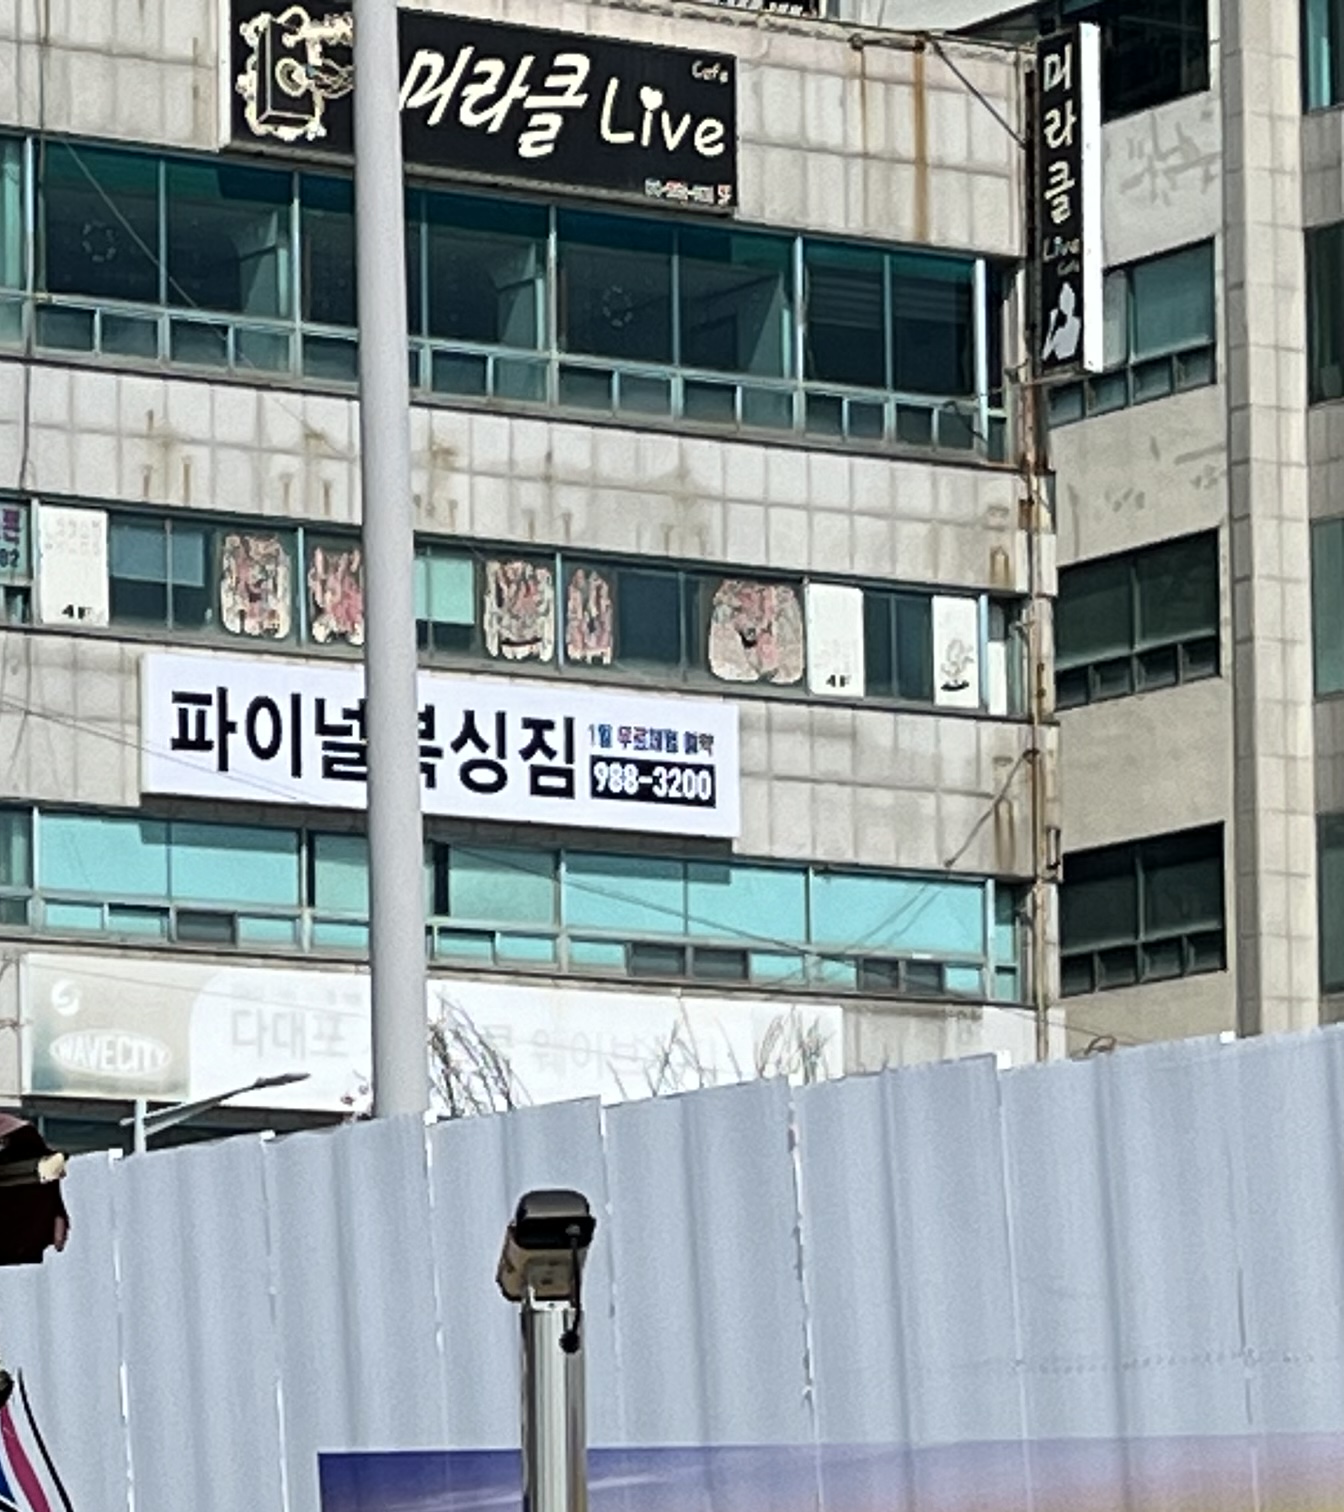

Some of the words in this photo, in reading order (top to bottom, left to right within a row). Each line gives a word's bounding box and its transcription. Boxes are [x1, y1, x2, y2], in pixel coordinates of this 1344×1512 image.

[398, 45, 592, 159] 미라클
[599, 77, 727, 157] Live
[1043, 42, 1076, 224] 미라클
[593, 762, 712, 801] 988-3200
